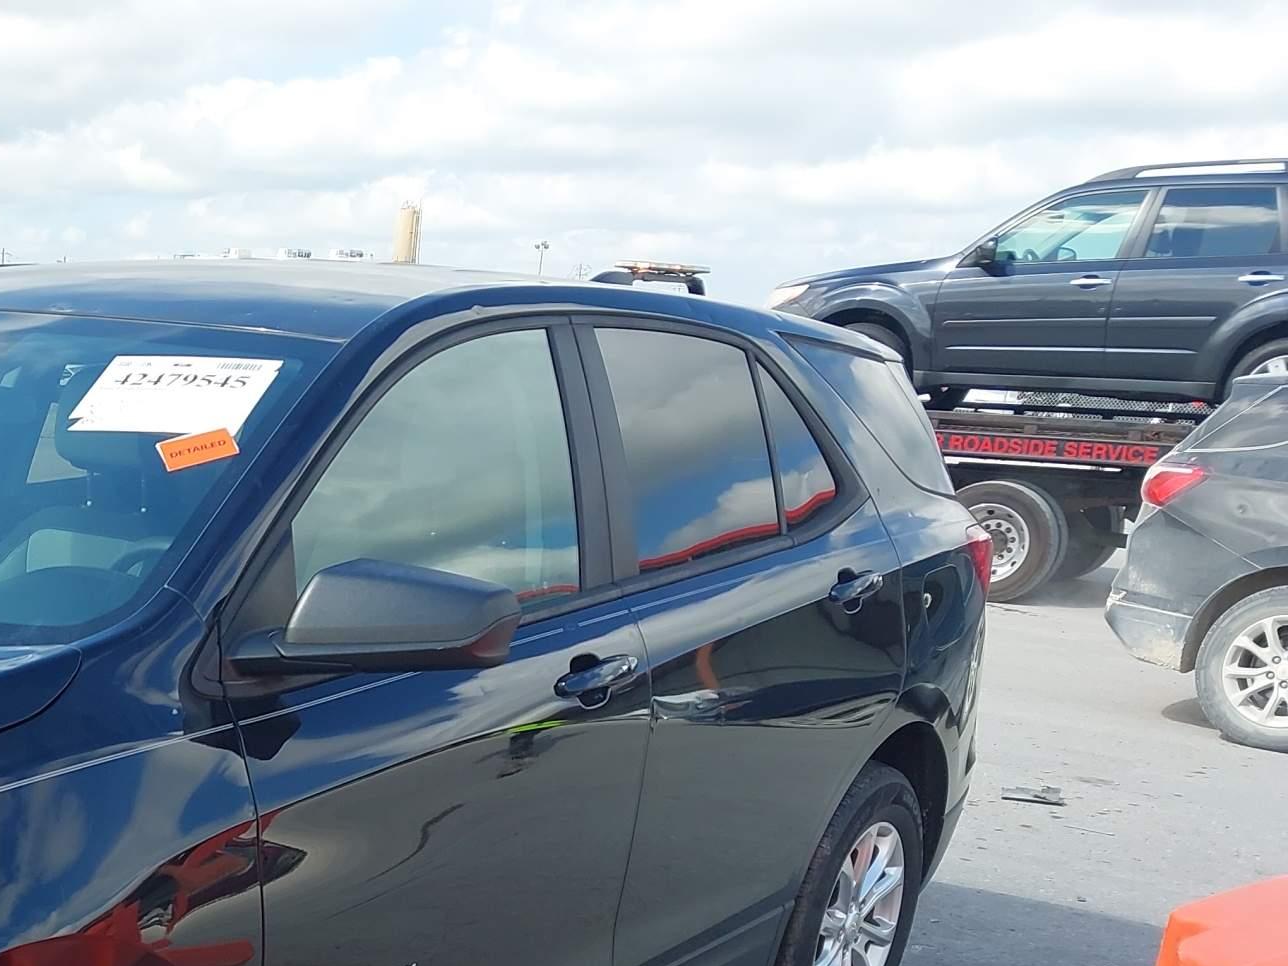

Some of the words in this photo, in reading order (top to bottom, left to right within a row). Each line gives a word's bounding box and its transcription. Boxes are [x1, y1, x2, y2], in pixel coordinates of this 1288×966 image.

[114, 372, 251, 389] 42479545
[169, 439, 226, 459] DETAILED
[948, 434, 1057, 457] ROADSIDE
[1064, 441, 1160, 464] SERVICE
